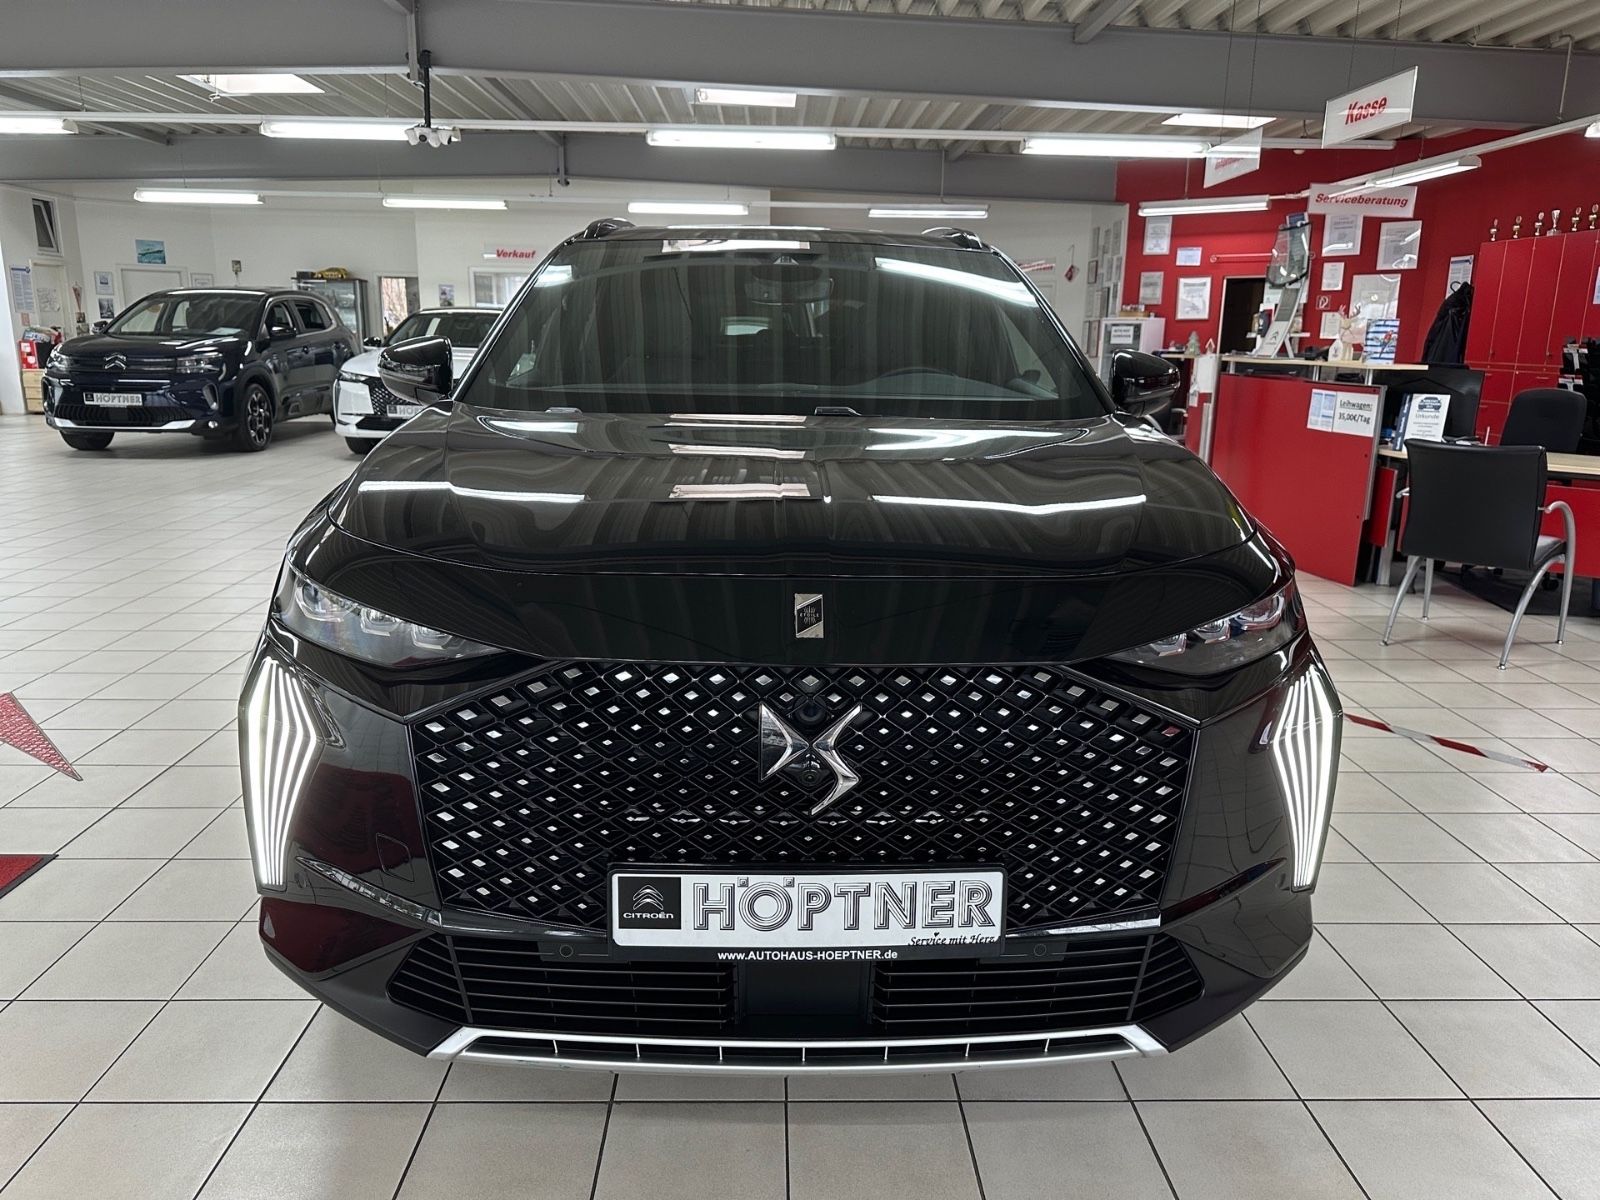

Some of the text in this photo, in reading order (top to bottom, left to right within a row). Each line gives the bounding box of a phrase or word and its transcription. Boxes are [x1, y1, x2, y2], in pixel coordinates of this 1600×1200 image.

[1345, 96, 1388, 125] Kasse
[1315, 193, 1409, 208] Serviceberatung
[496, 249, 536, 259] Verkauf
[1339, 399, 1374, 411] Leihwagen:
[1338, 412, 1371, 424] 35,00€/Tag
[692, 876, 997, 932] HÖPTNER
[908, 933, 996, 947] Service mit Herz
[717, 949, 899, 961] www.AUTOHAUS-HOEPTNER.de
